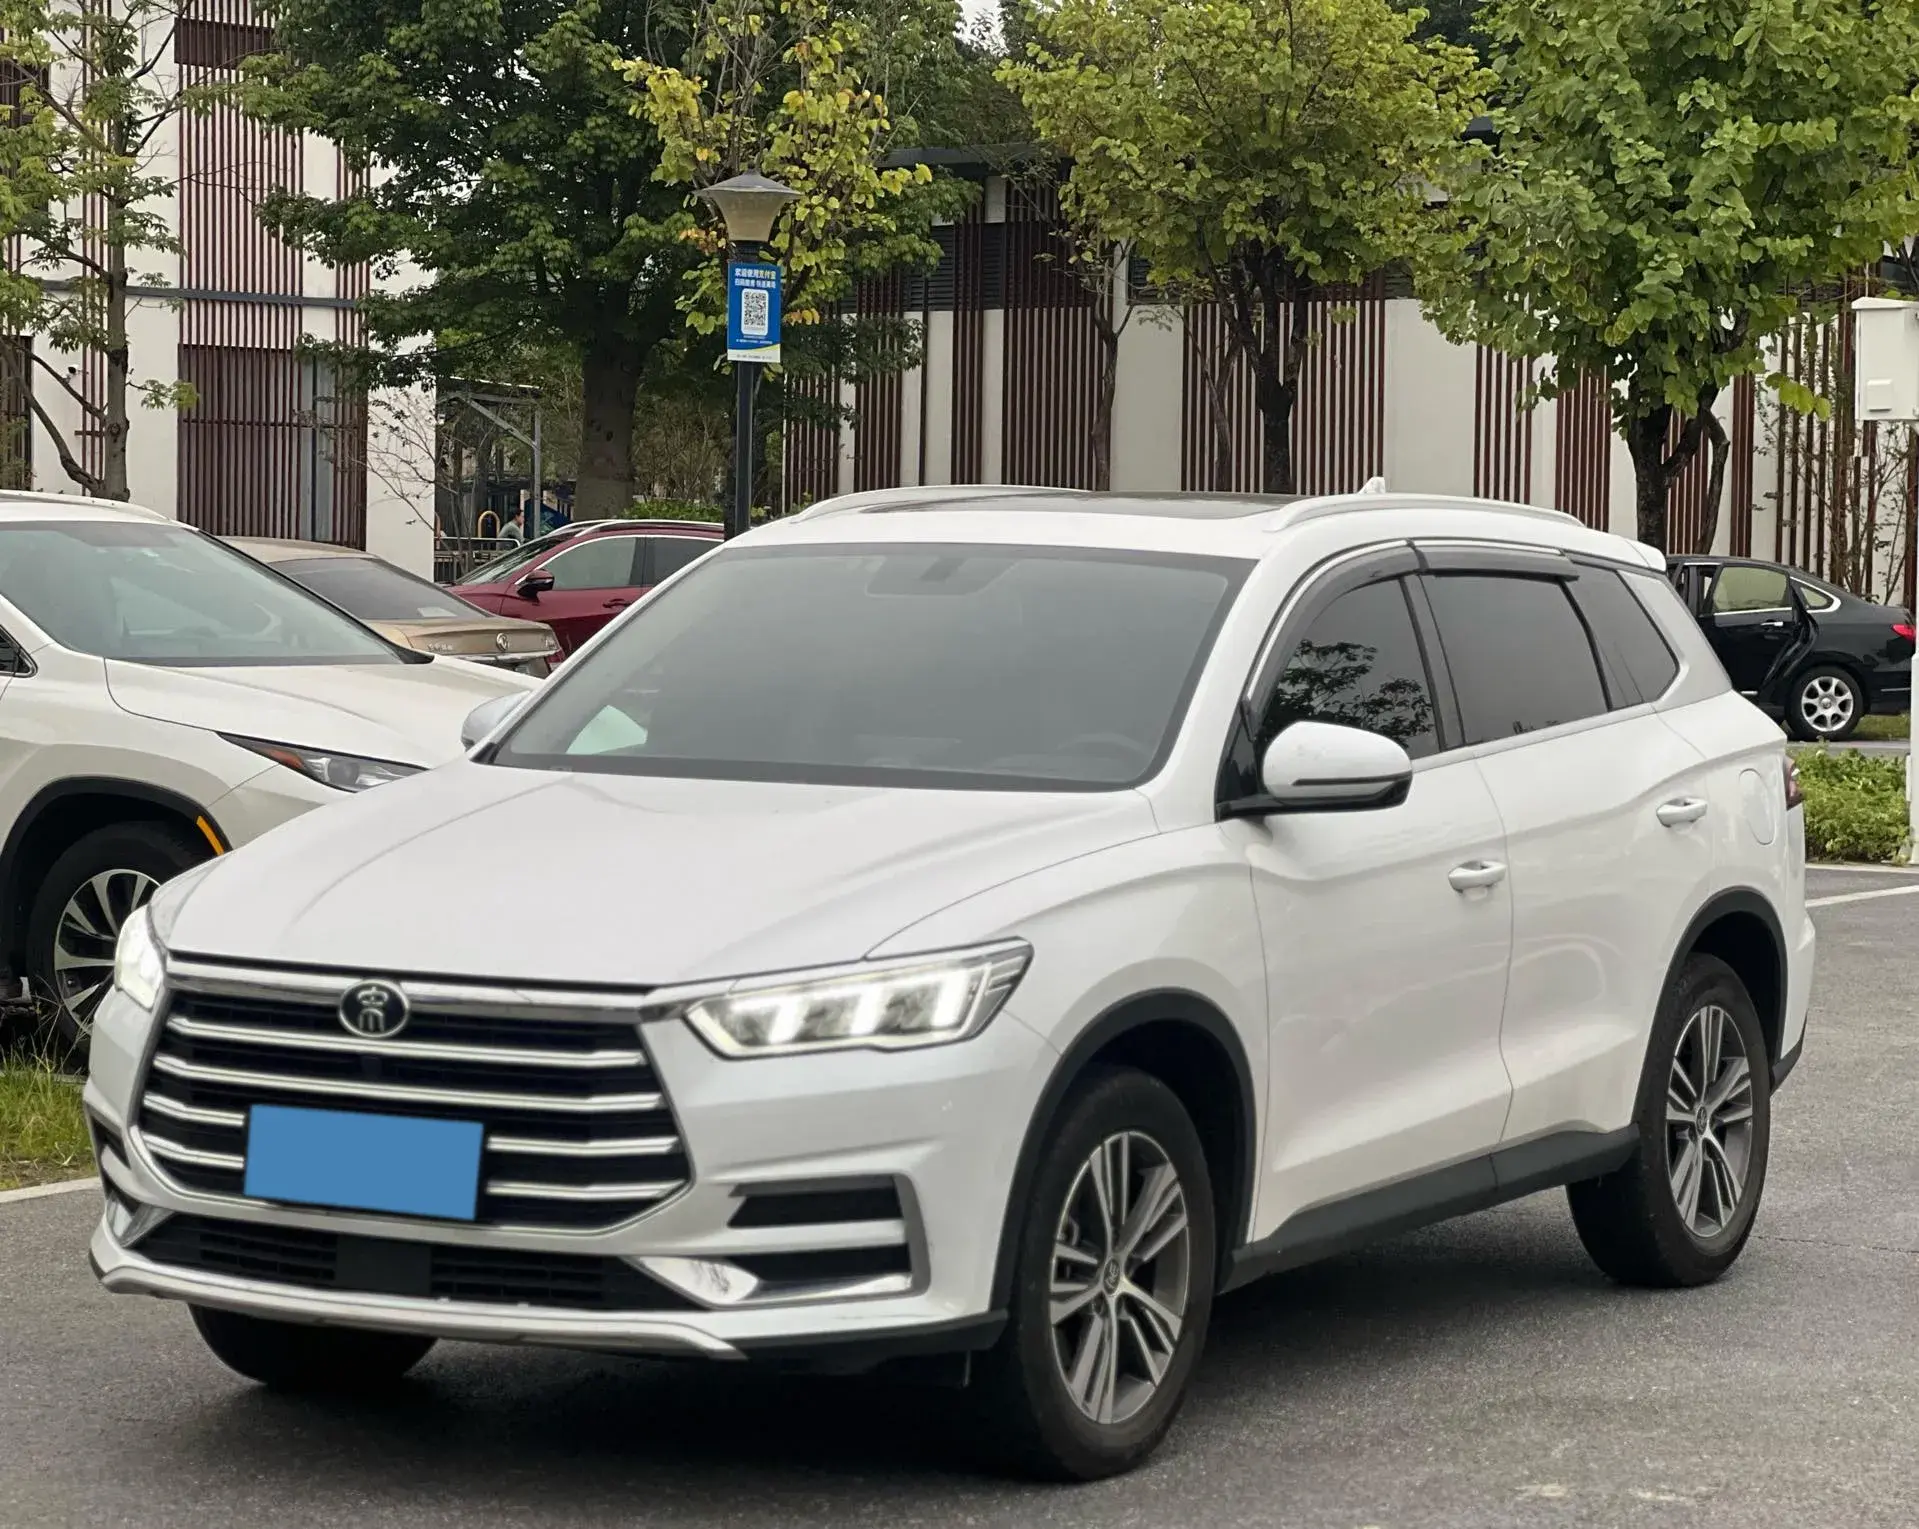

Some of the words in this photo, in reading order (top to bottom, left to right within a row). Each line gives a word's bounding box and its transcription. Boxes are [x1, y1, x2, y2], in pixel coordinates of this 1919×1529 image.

[735, 268, 776, 280] 欢迎使用支付宝
